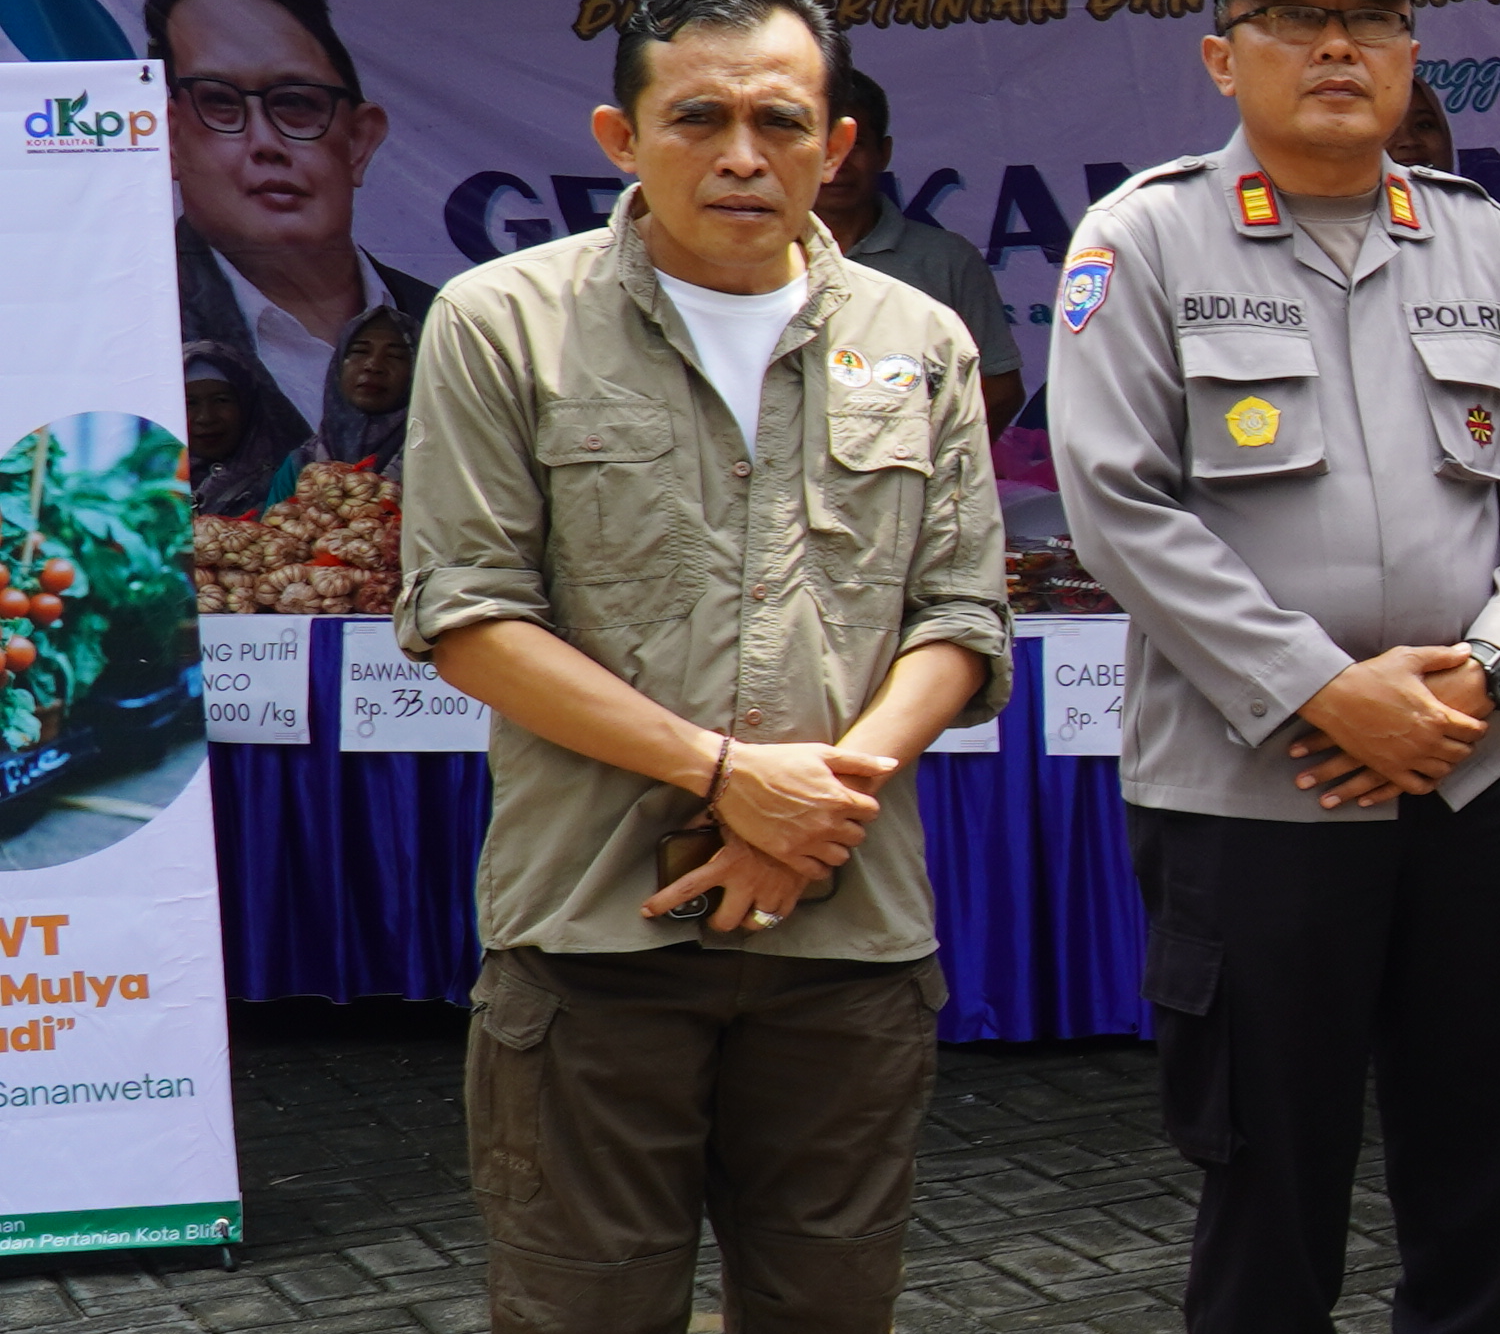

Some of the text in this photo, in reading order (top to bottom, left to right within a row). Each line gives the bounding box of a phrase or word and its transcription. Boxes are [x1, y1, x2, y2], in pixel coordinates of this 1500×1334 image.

[26, 138, 96, 147] KOTA BLITAR
[1184, 296, 1303, 328] BUDI AGUS
[240, 641, 299, 662] PUTIH
[202, 672, 251, 692] NCO
[350, 662, 440, 682] BAWANG
[203, 700, 297, 728] .000 /kg
[354, 697, 388, 722] Rp.
[1066, 706, 1098, 730] Rp.
[0, 970, 151, 1009] Mulya
[0, 1234, 34, 1251] dan
[39, 1230, 131, 1248] Pertanian
[135, 1227, 181, 1243] Kota
